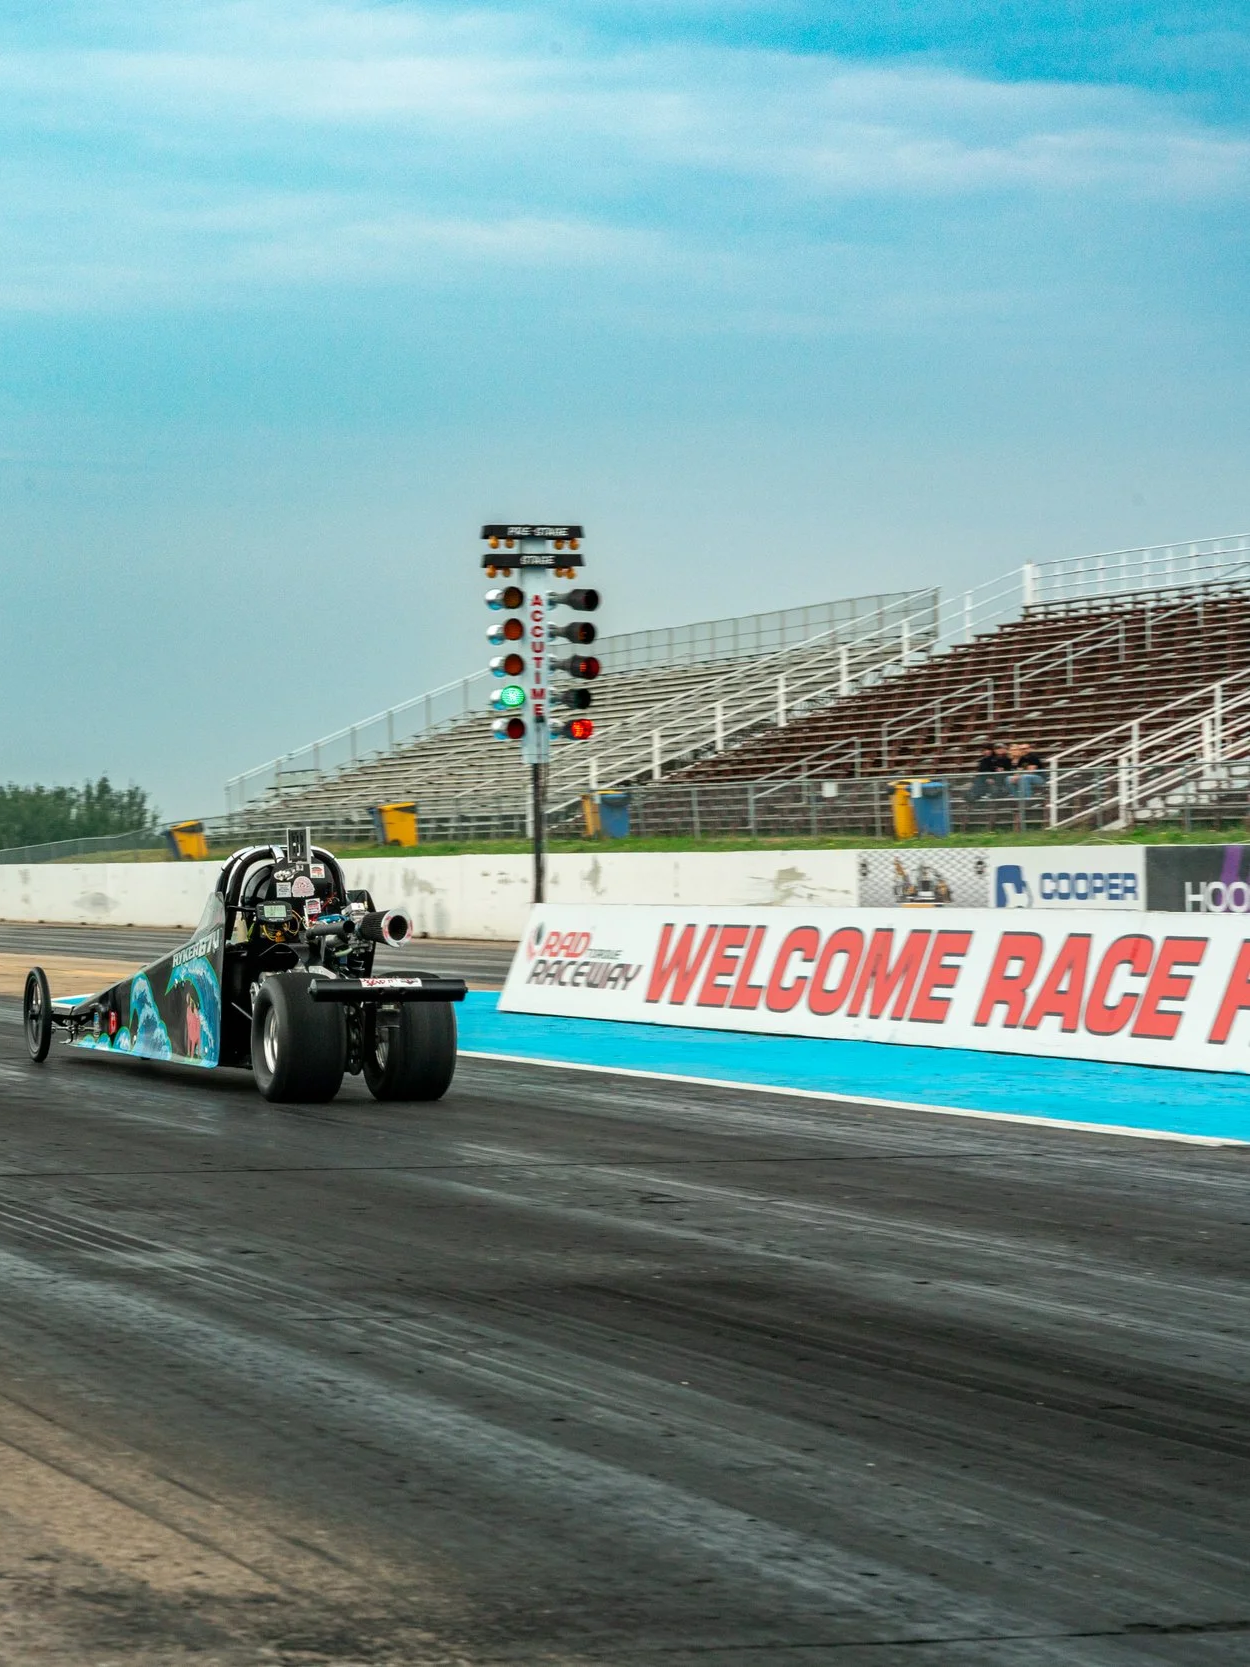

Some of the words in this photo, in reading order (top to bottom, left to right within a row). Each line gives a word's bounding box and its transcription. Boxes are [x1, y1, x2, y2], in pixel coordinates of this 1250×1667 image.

[507, 526, 569, 536] PRE-STAGE
[520, 555, 555, 565] STAGE
[530, 594, 545, 716] ACCUTIME
[1040, 872, 1138, 901] COOPER
[540, 931, 591, 958] RAD
[526, 958, 643, 990] RACEWAY
[645, 923, 973, 1024] WELCOME
[974, 931, 1210, 1041] RACE
